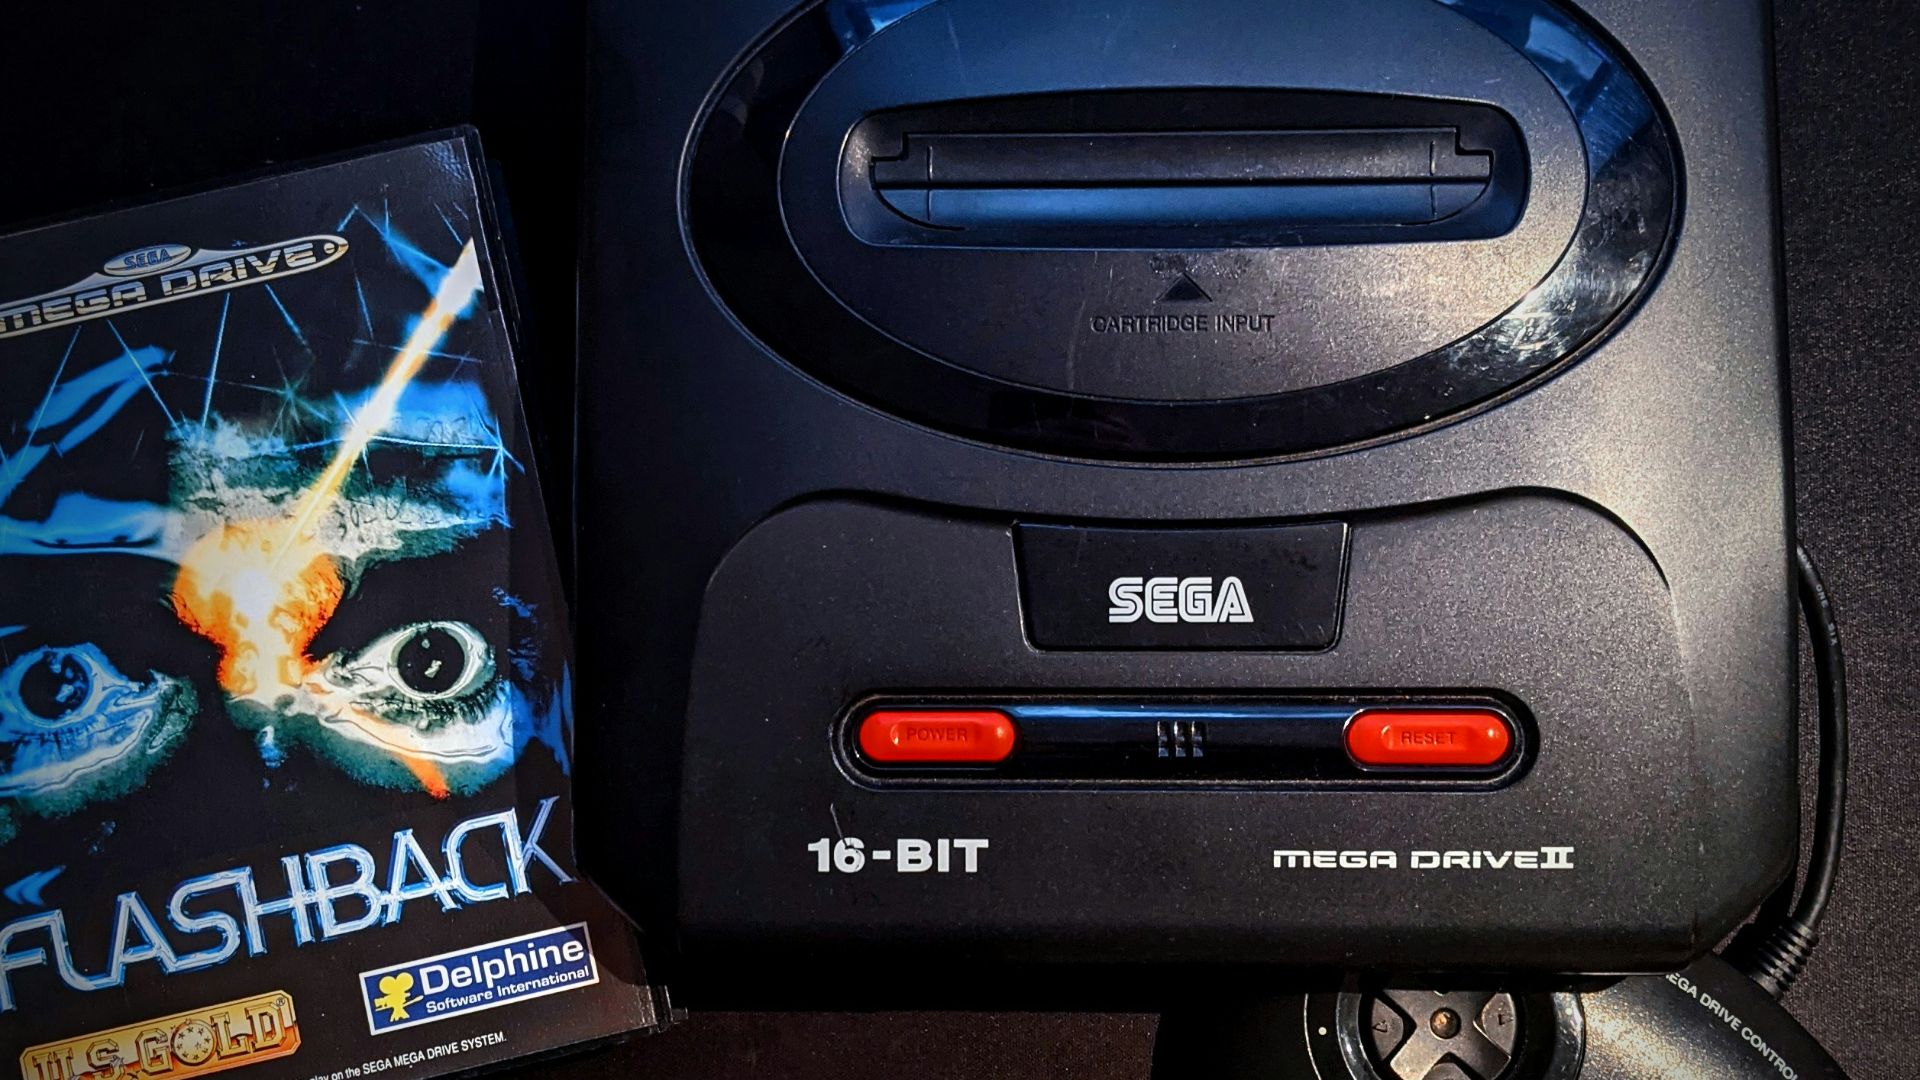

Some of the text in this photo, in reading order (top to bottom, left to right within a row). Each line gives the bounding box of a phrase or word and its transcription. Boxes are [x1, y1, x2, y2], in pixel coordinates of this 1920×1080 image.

[124, 248, 172, 270] SEGA
[0, 242, 317, 332] MEGA DRIVE
[1090, 314, 1275, 333] CARTRIDGE INPUT
[1108, 576, 1254, 623] SEGA
[906, 727, 968, 742] POWER
[1401, 731, 1456, 745] RESET
[807, 837, 989, 874] 16-BIT
[1273, 850, 1397, 869] MEGA
[0, 796, 577, 1013] FLASHBACK
[419, 938, 585, 996] Delphine
[425, 966, 589, 1014] Software International
[1665, 972, 1697, 998] EGA
[1699, 992, 1742, 1031] DRIVE
[135, 1001, 288, 1074] GOLD
[331, 1071, 344, 1080] on
[345, 1067, 361, 1079] the
[362, 1057, 392, 1075] SEGA
[393, 1050, 425, 1068] MEGA
[426, 1041, 459, 1059] DRIVE
[460, 1031, 507, 1051] SYSTEM.
